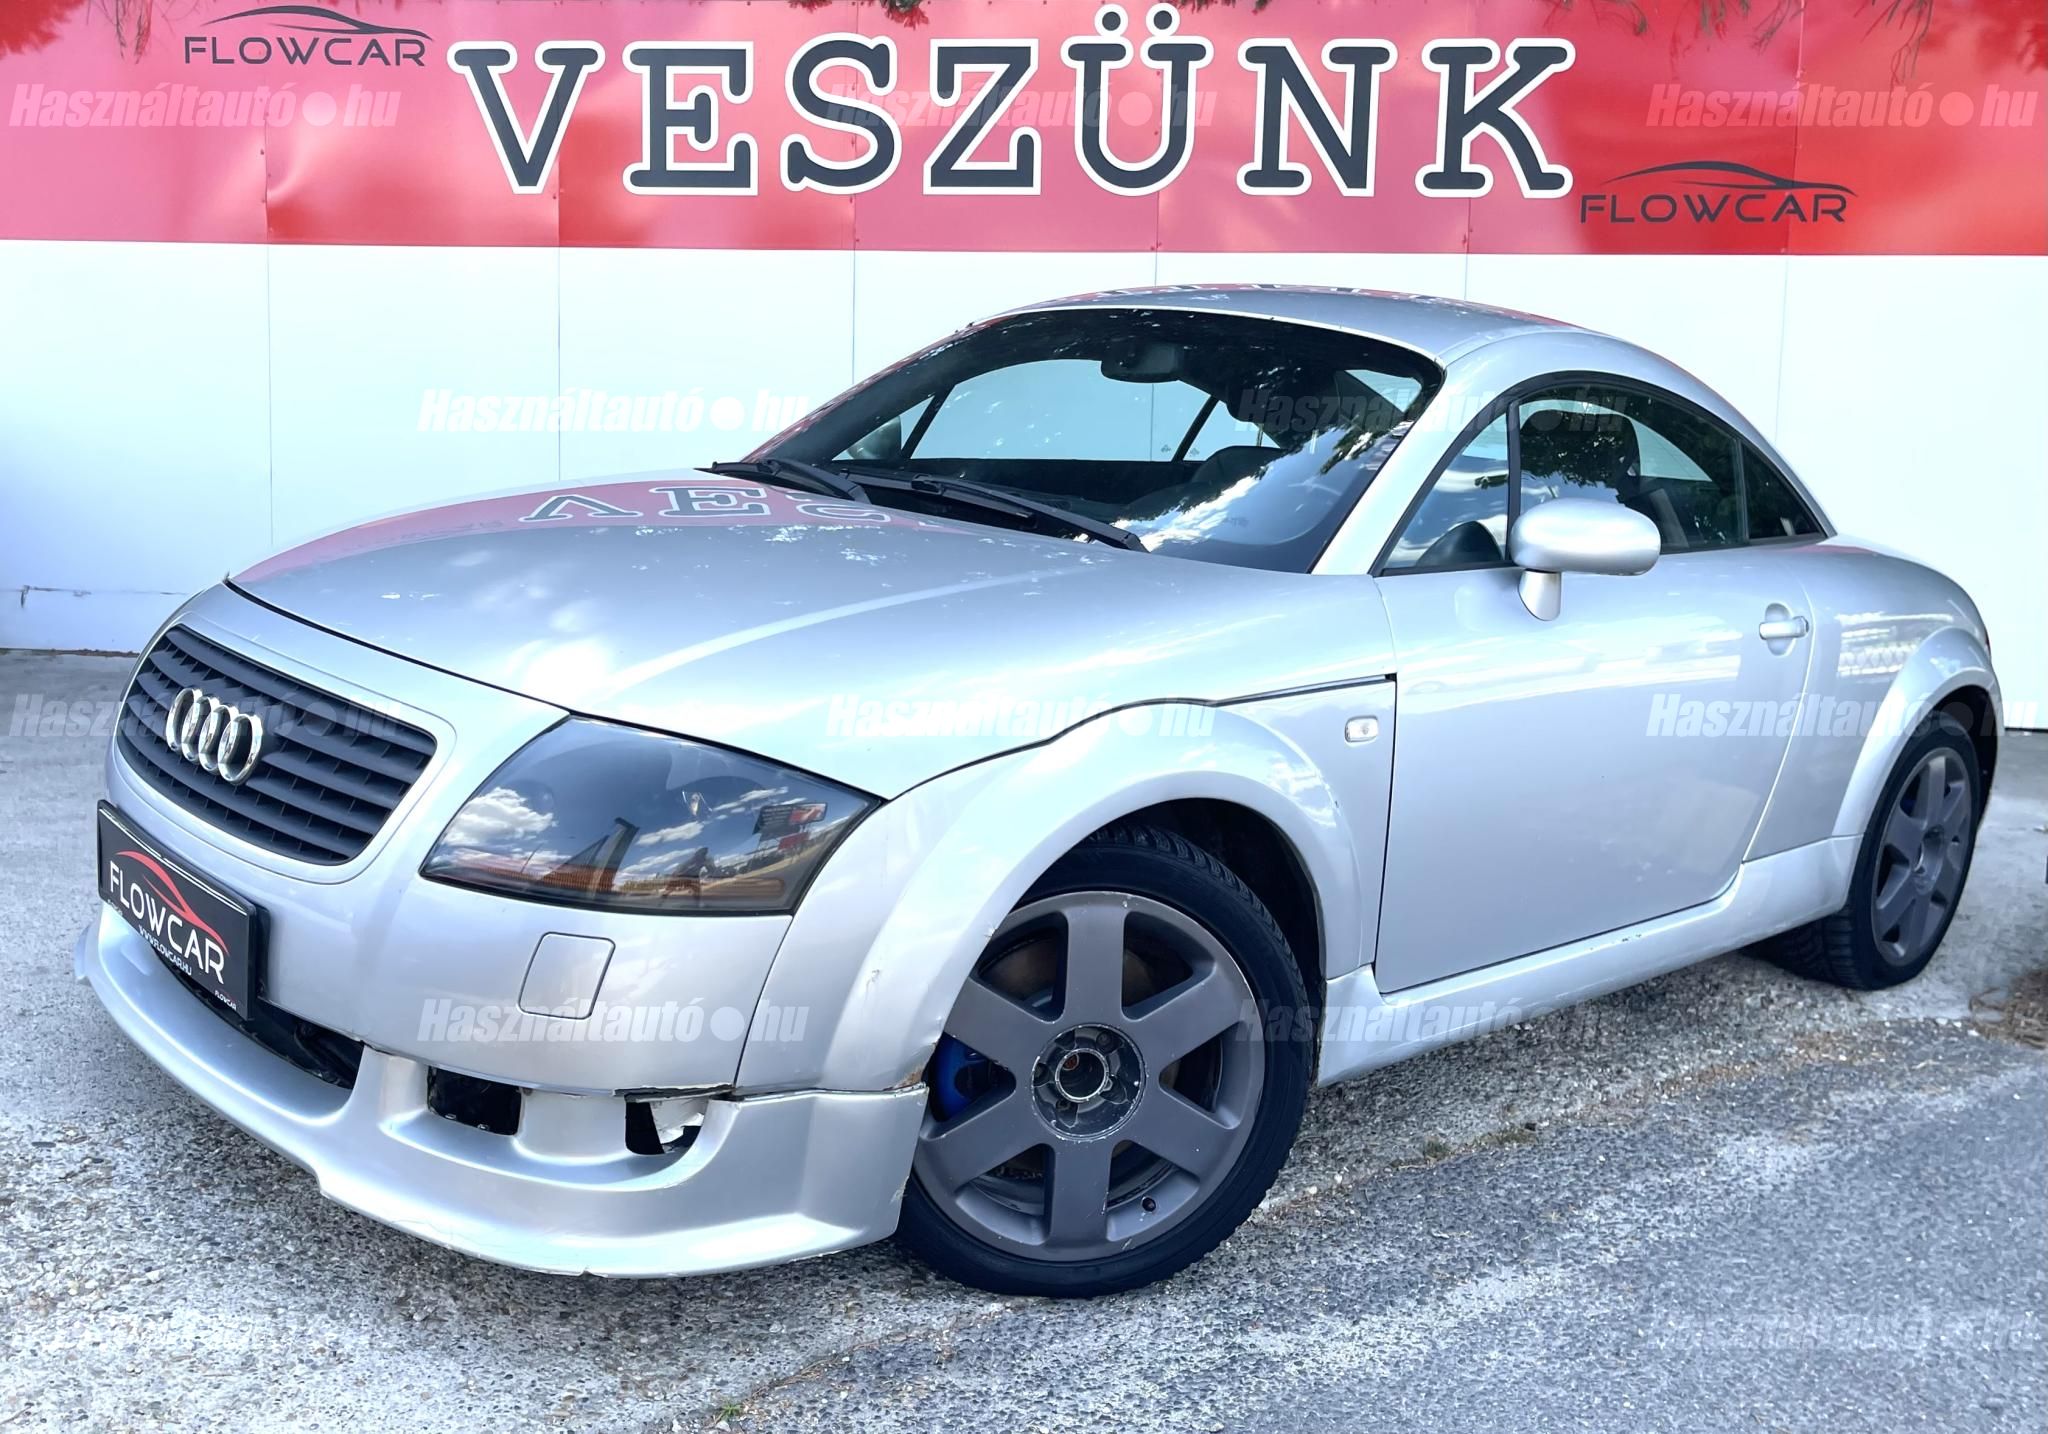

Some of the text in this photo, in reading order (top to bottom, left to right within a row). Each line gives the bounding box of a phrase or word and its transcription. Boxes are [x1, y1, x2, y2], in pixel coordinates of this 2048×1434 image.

[184, 36, 426, 67] FLOWCAR
[446, 4, 1576, 199] VESZÜNK
[1579, 193, 1847, 224] FLOWCAR
[110, 861, 225, 985] FLOWCAR
